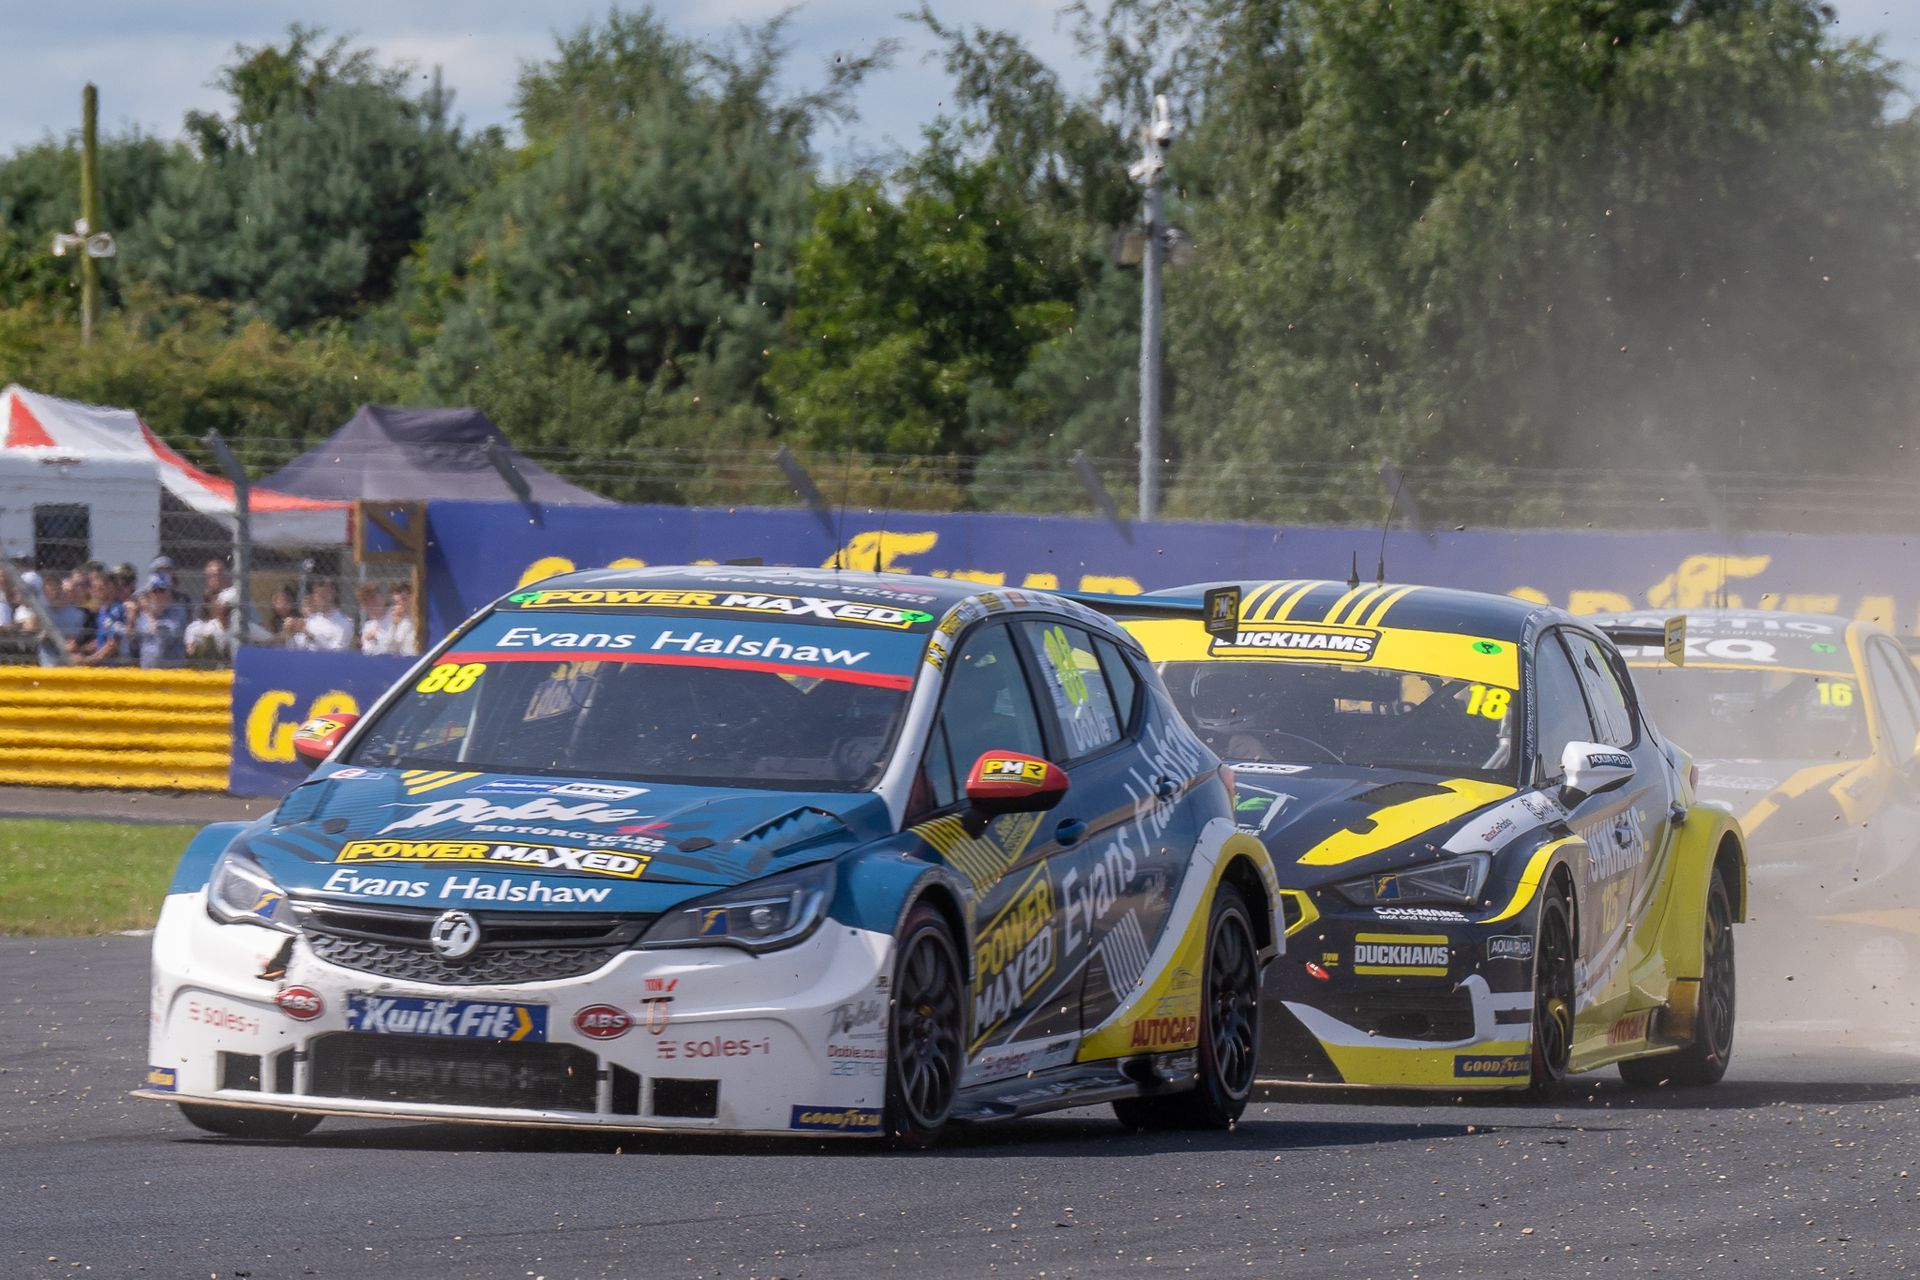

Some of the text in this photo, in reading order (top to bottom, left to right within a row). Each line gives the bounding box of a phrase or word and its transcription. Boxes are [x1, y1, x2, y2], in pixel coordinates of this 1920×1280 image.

[535, 591, 718, 606] POWER
[721, 594, 904, 624] MAXED
[496, 627, 872, 666] Evans Halshaw
[416, 662, 488, 694] 88
[1466, 684, 1511, 720] 18
[1816, 682, 1854, 707] 16
[985, 761, 1042, 776] PMR
[1590, 754, 1613, 764] AQUA
[471, 824, 667, 848] MOTORCYCLES
[346, 842, 640, 875] POWER MAXED
[323, 868, 612, 904] Evans Halshaw
[1061, 826, 1136, 957] Evans
[975, 879, 1051, 993] POWER
[1491, 939, 1531, 955] AQUA PURA
[1354, 944, 1449, 966] DUCKHAMS
[973, 924, 1052, 1040] MAXED
[581, 1013, 627, 1029] ABS
[1131, 1016, 1197, 1048] AUTOCAR
[684, 1036, 770, 1058] sales-i
